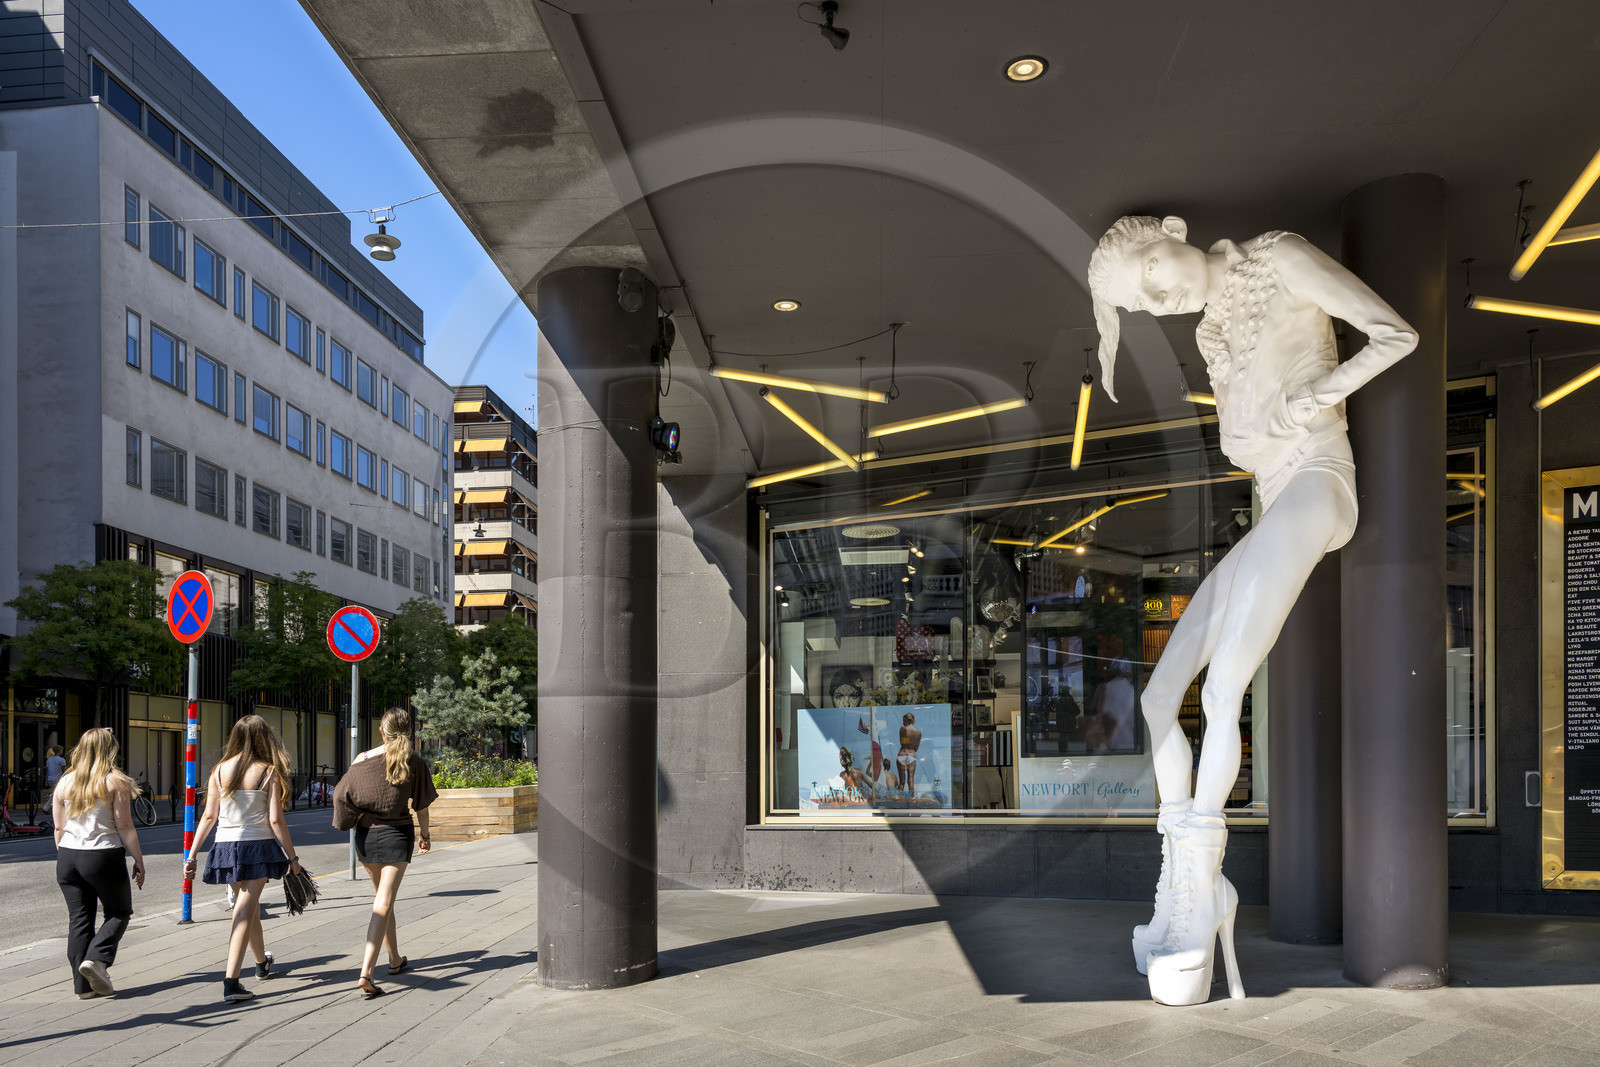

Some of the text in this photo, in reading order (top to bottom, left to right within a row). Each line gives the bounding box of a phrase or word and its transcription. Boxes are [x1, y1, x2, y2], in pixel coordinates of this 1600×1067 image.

[35, 697, 46, 708] 59
[1021, 781, 1140, 799] NEWPORT Gallery
